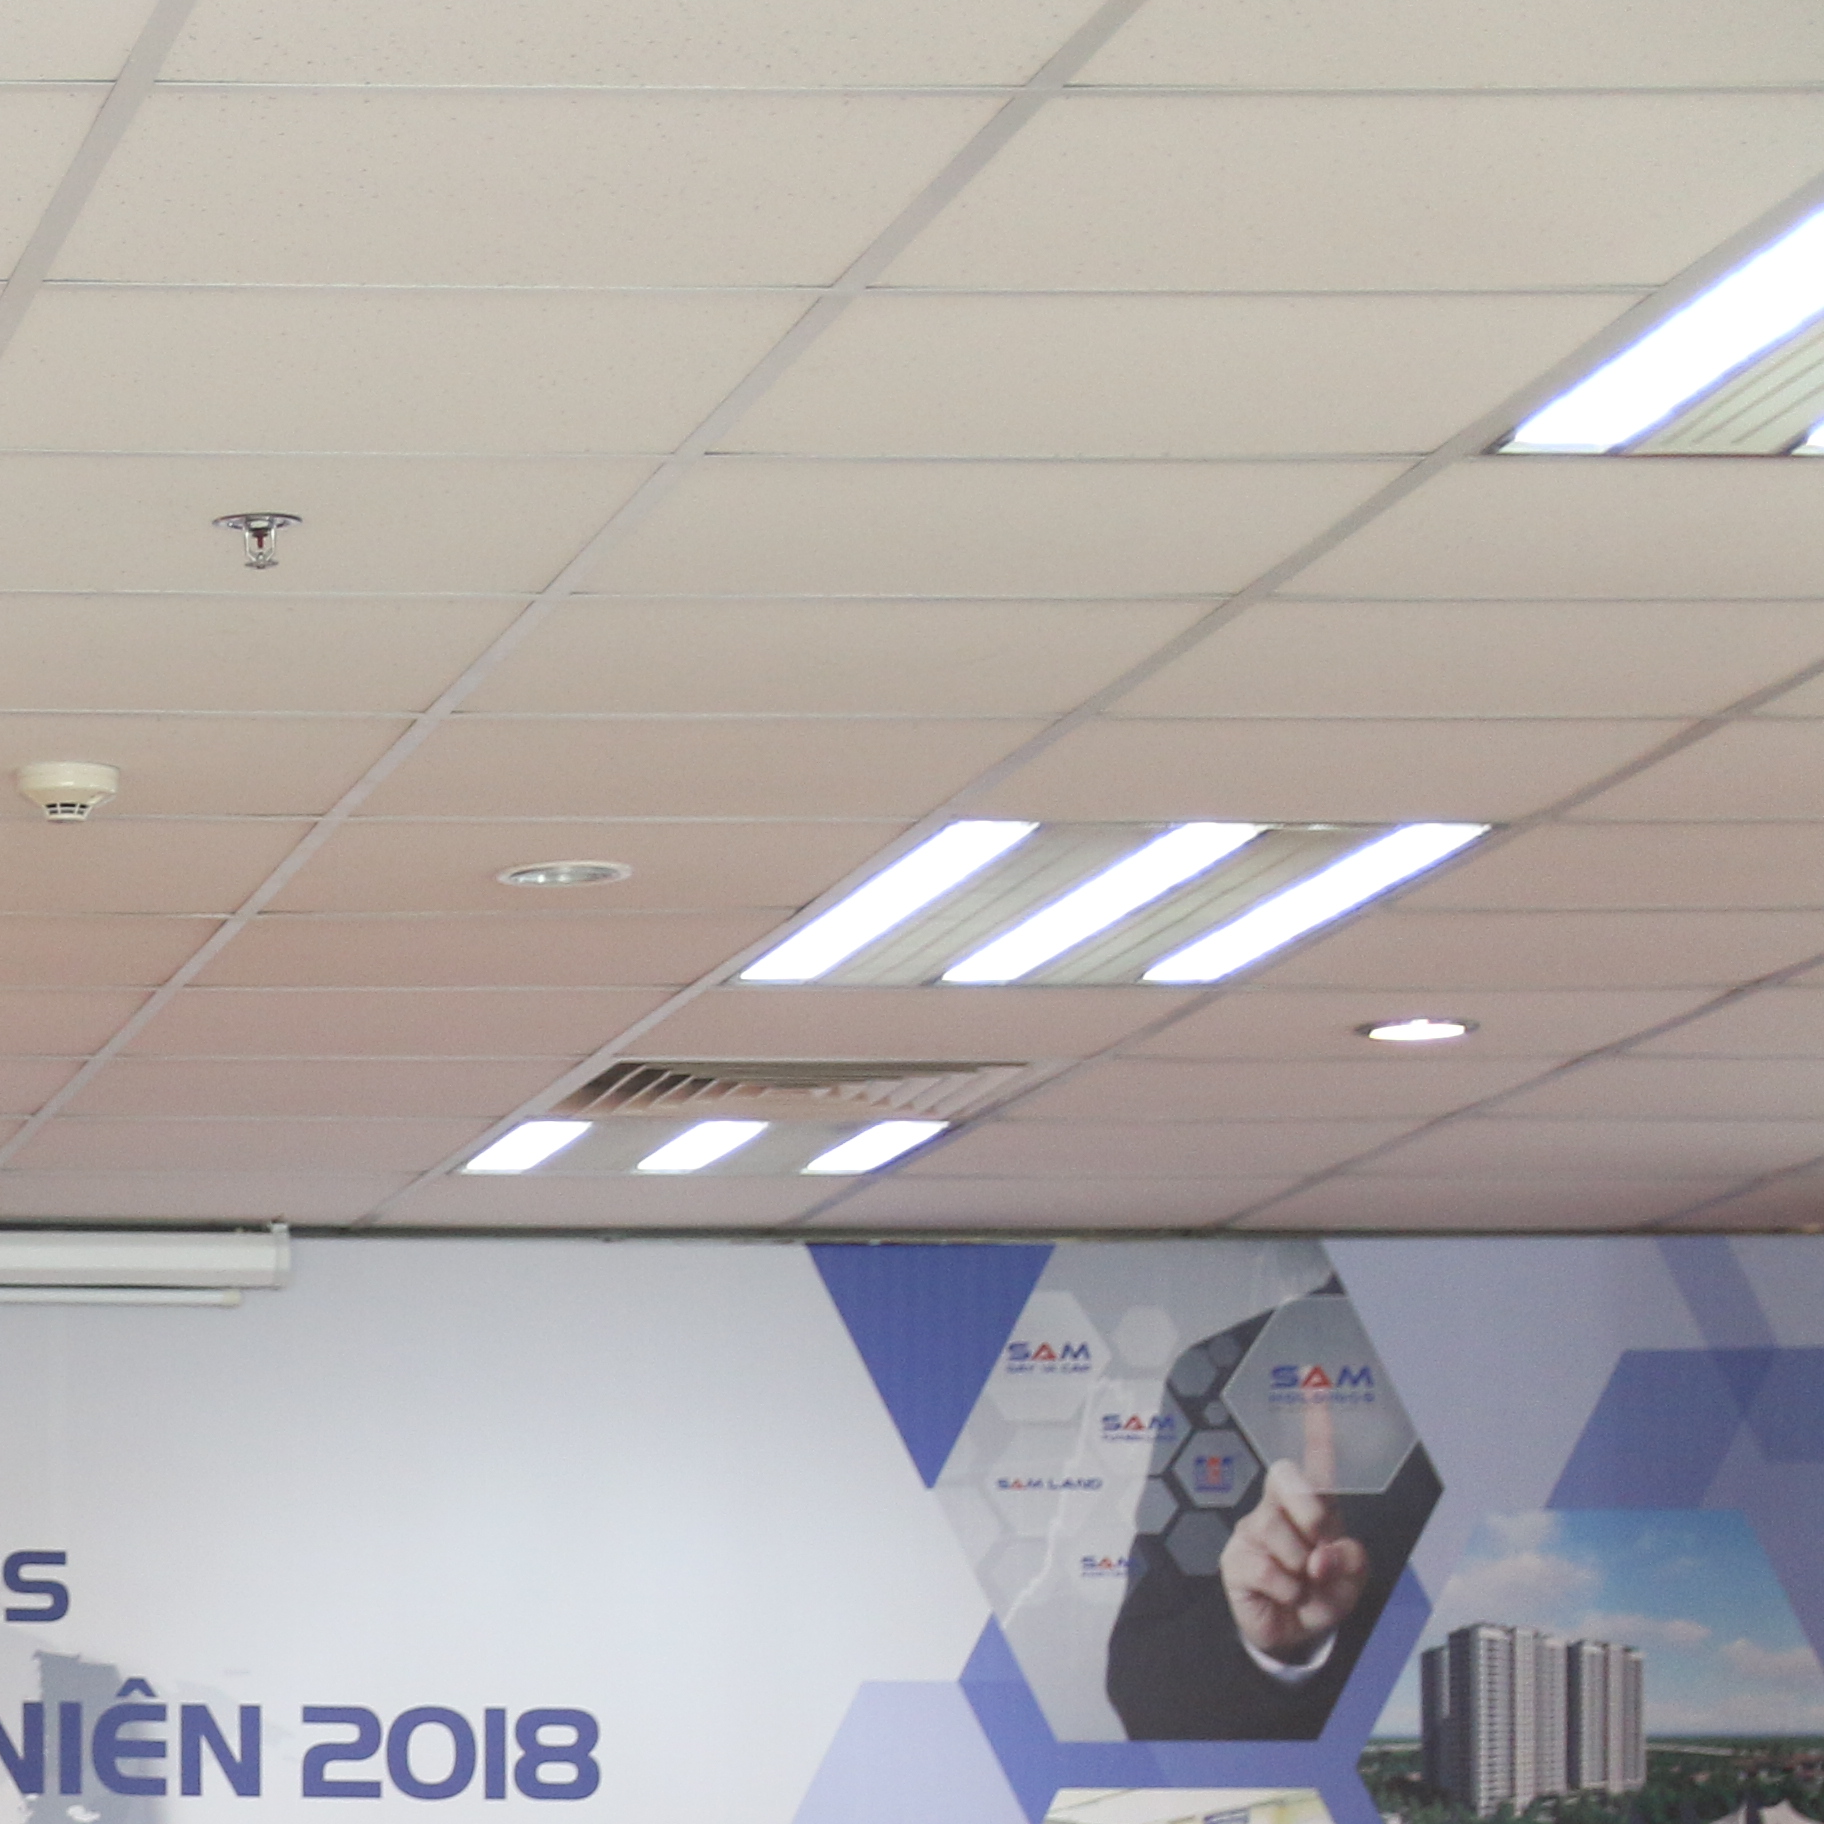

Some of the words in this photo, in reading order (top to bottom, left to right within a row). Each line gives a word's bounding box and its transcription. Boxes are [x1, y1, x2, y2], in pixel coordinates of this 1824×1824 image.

[1008, 1341, 1091, 1361] SAM
[1271, 1364, 1374, 1388] SAM
[1101, 1413, 1176, 1431] SAM
[300, 1704, 602, 1803] 2018
